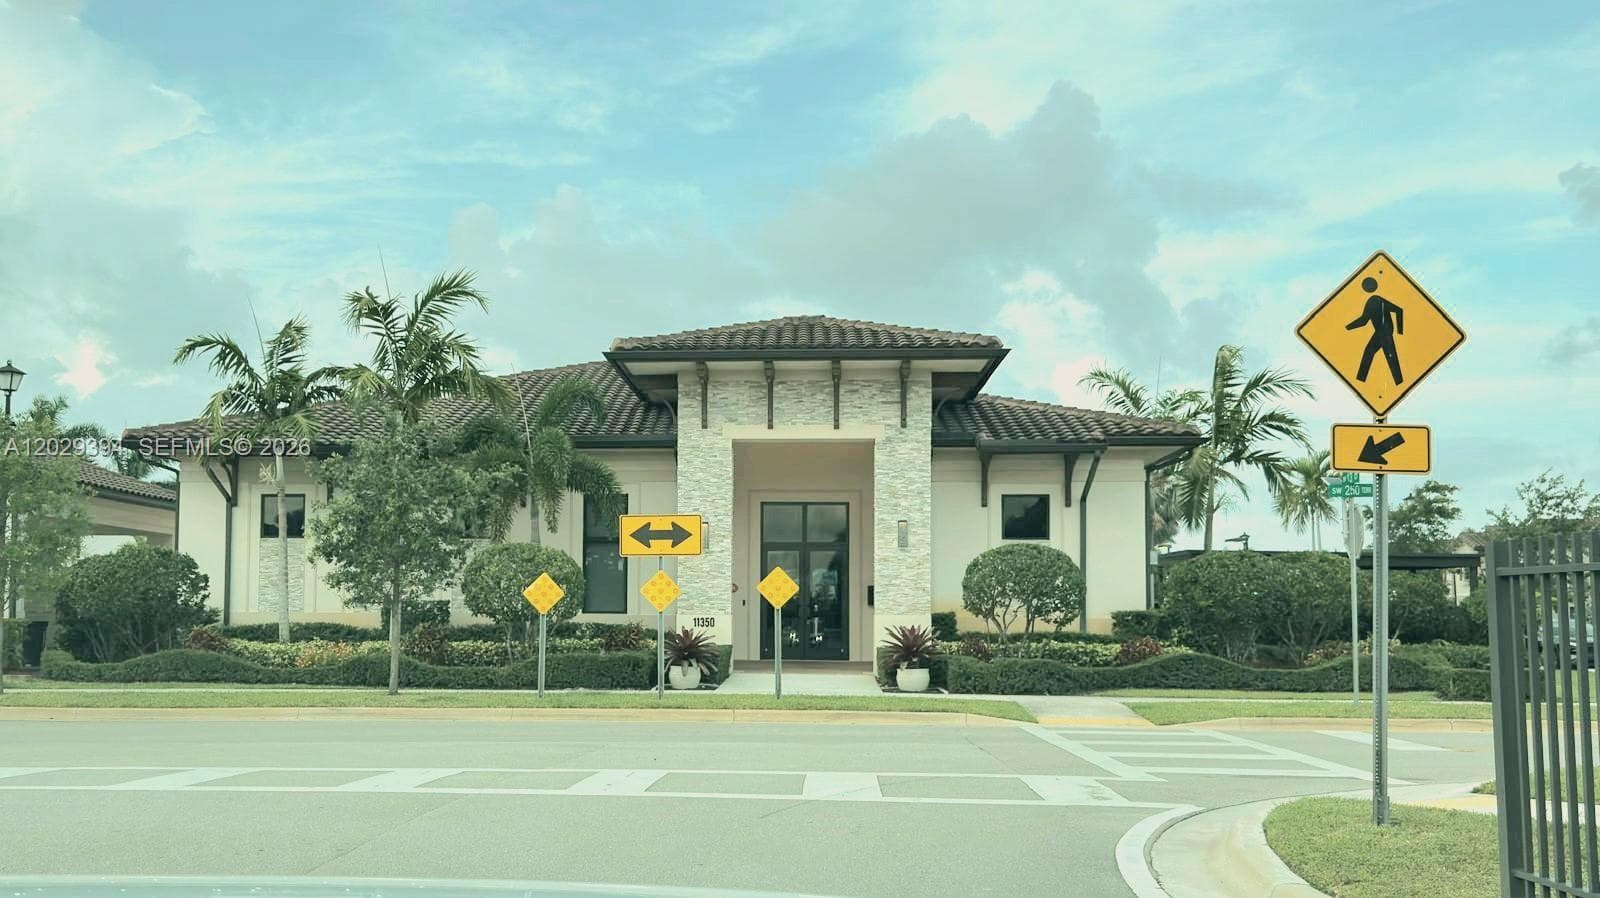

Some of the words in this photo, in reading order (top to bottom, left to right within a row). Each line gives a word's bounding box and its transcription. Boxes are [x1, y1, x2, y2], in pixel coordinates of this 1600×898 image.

[1332, 487, 1342, 495] SW
[1345, 485, 1360, 495] 250
[693, 617, 715, 628] 11350
